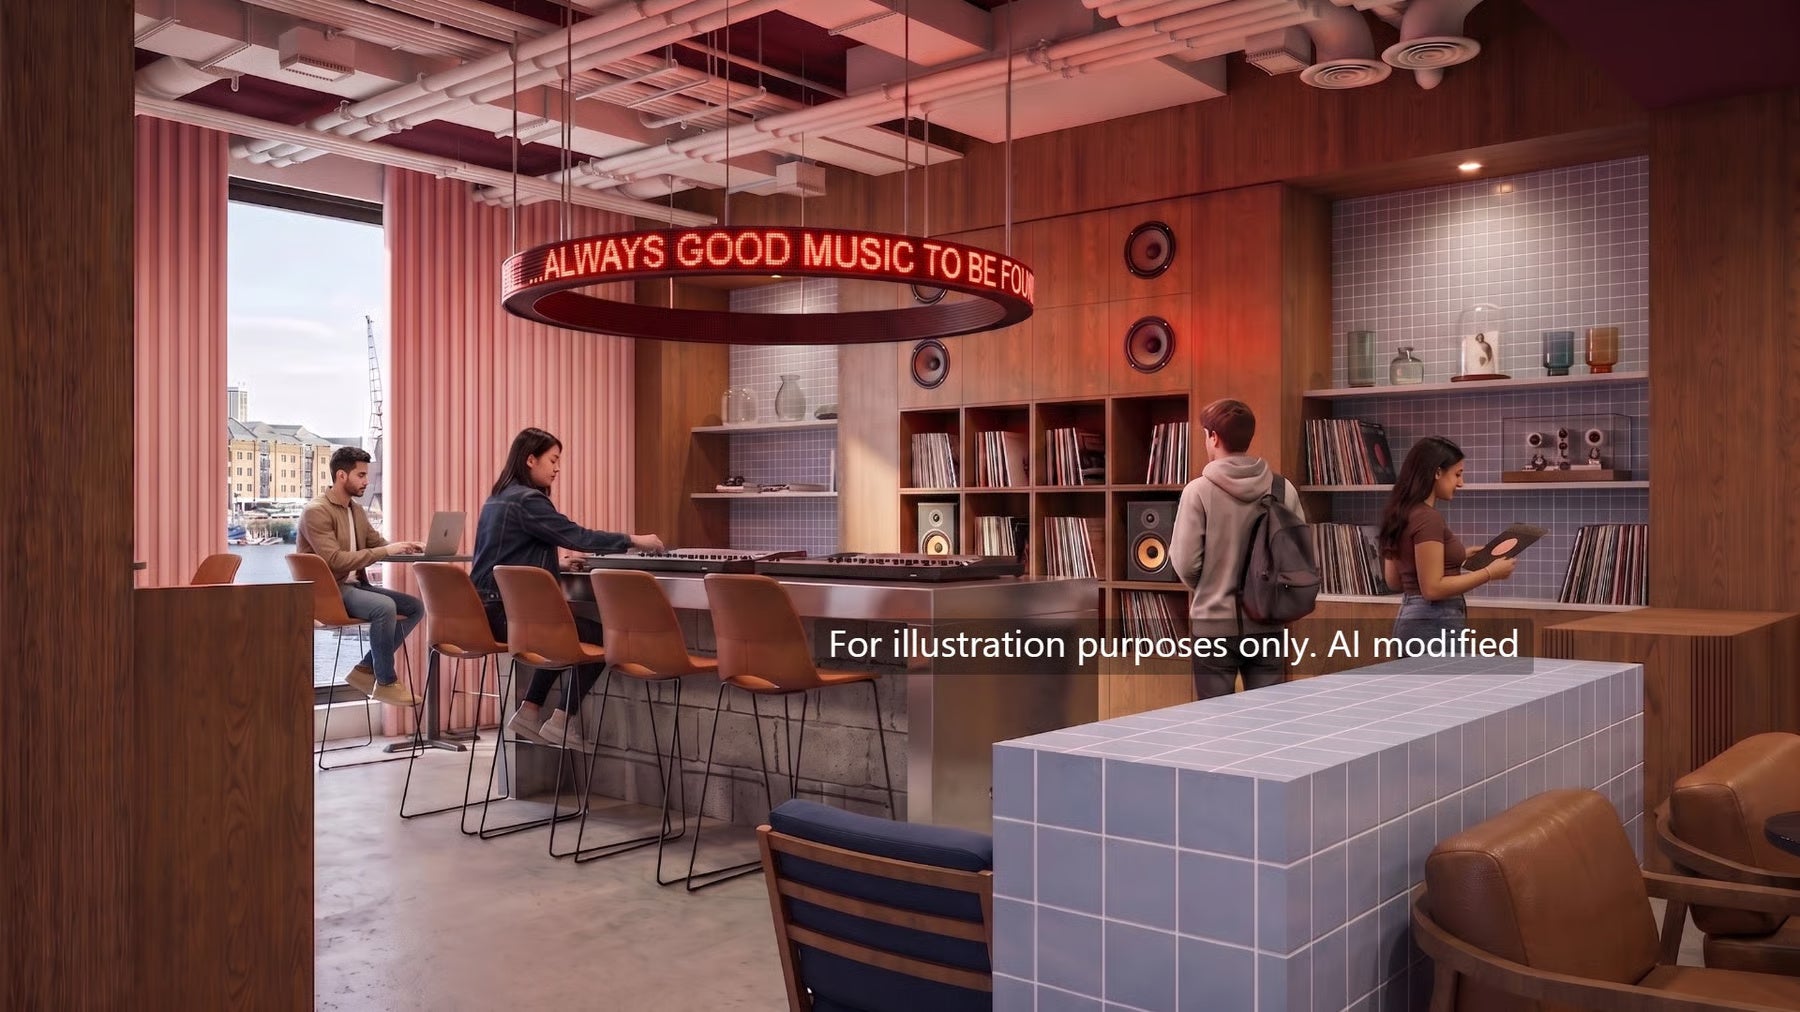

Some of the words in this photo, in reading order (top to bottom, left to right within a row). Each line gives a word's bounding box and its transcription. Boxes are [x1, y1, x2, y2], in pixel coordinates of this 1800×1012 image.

[677, 232, 791, 266] GOOD
[803, 233, 914, 273] MUSIC
[924, 244, 961, 279] TO
[968, 251, 997, 287] BE
